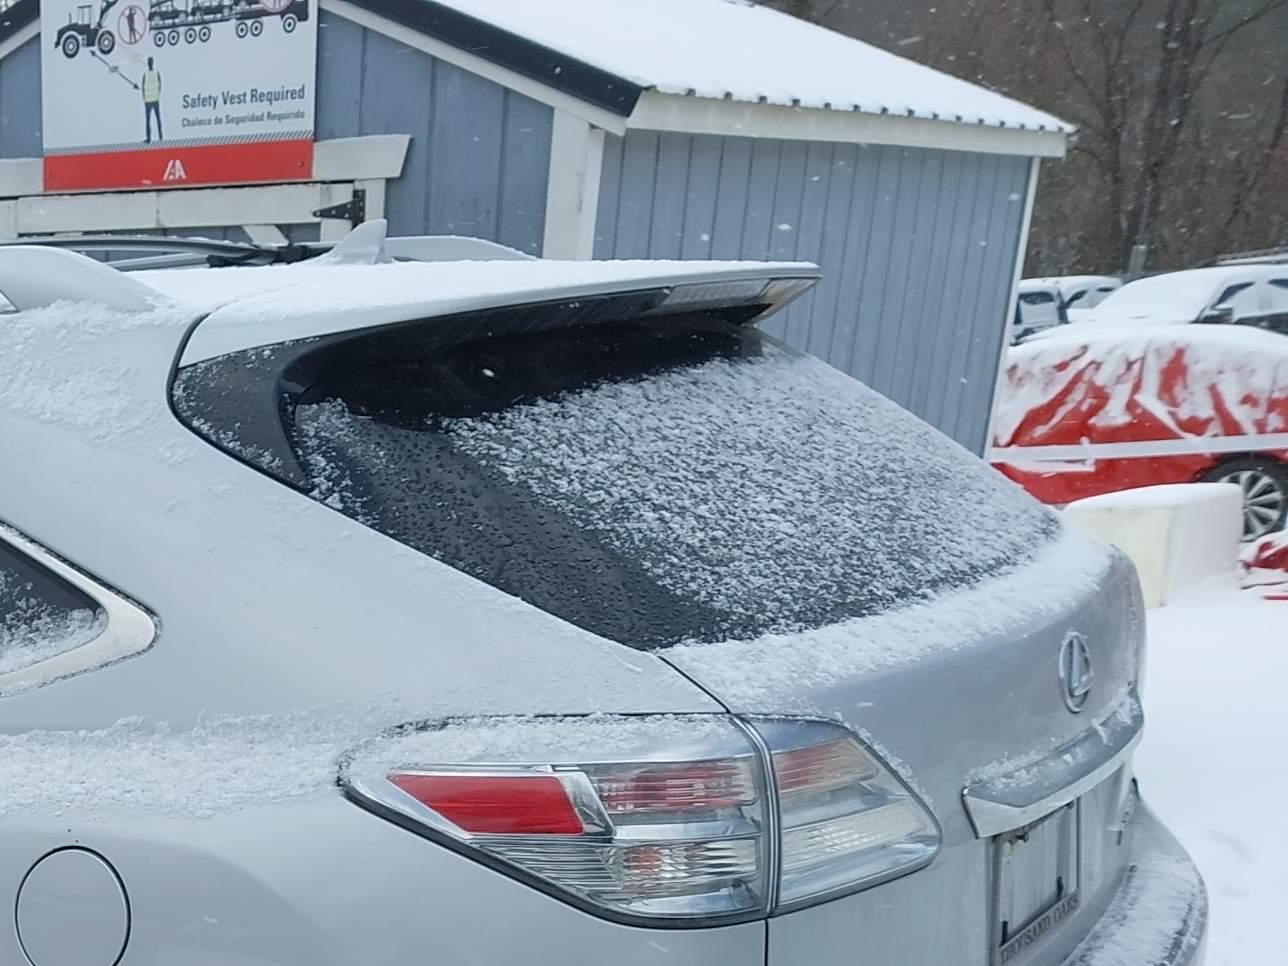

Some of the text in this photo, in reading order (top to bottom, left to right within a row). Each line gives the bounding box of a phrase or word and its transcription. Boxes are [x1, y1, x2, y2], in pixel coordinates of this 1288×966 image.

[182, 83, 306, 110] Safety Vest Required
[214, 115, 224, 126] de
[225, 112, 266, 126] Seguridad
